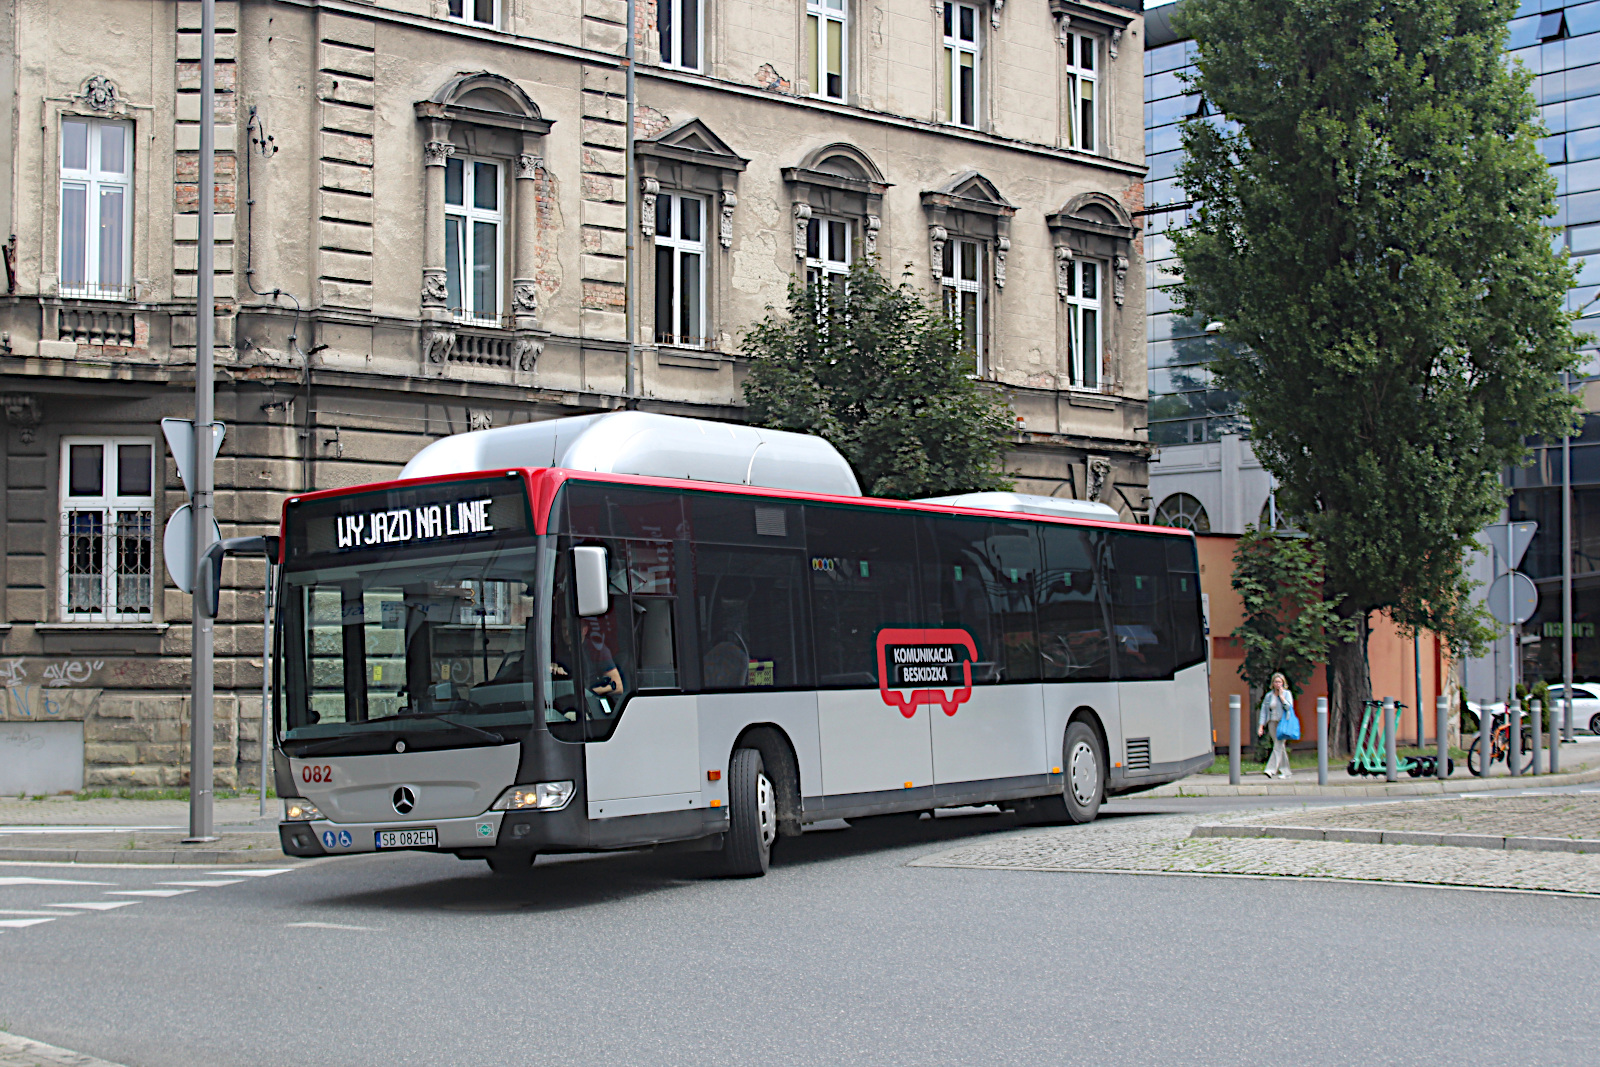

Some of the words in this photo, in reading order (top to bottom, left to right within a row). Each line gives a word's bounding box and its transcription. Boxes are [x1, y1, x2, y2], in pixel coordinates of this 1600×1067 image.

[337, 509, 412, 548] WYJAZD
[415, 505, 442, 538] NA
[446, 499, 493, 535] LINIE
[1544, 622, 1595, 637] naura
[894, 648, 953, 663] KOMUNIKACJA
[903, 666, 948, 682] BESKIDZKA
[302, 765, 332, 783] 082
[382, 832, 396, 847] SB
[400, 831, 434, 846] 082EH
